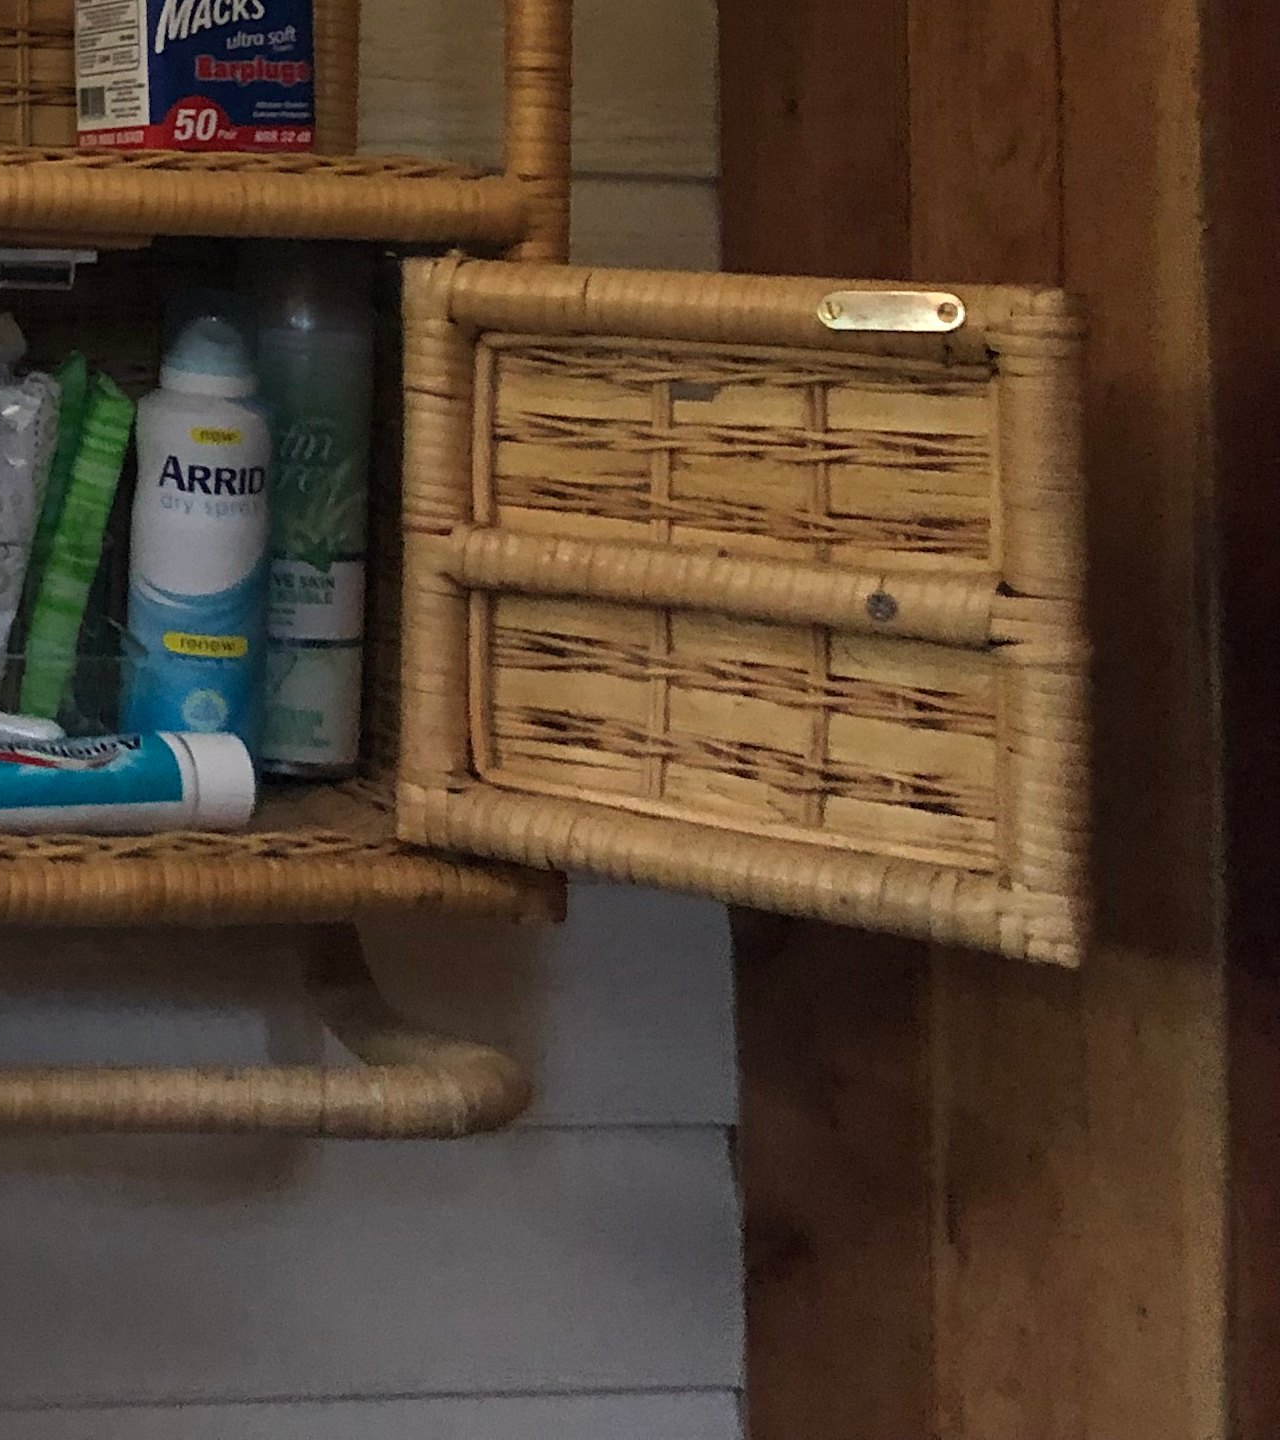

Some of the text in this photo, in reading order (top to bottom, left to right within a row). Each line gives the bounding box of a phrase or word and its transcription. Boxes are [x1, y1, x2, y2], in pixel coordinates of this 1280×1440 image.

[226, 29, 264, 50] ultra
[267, 24, 298, 45] soft
[195, 54, 309, 87] Earplugs
[173, 108, 219, 142] 50
[200, 429, 238, 442] new
[159, 454, 265, 496] ARRID
[160, 494, 193, 515] dry
[179, 636, 234, 652] renew
